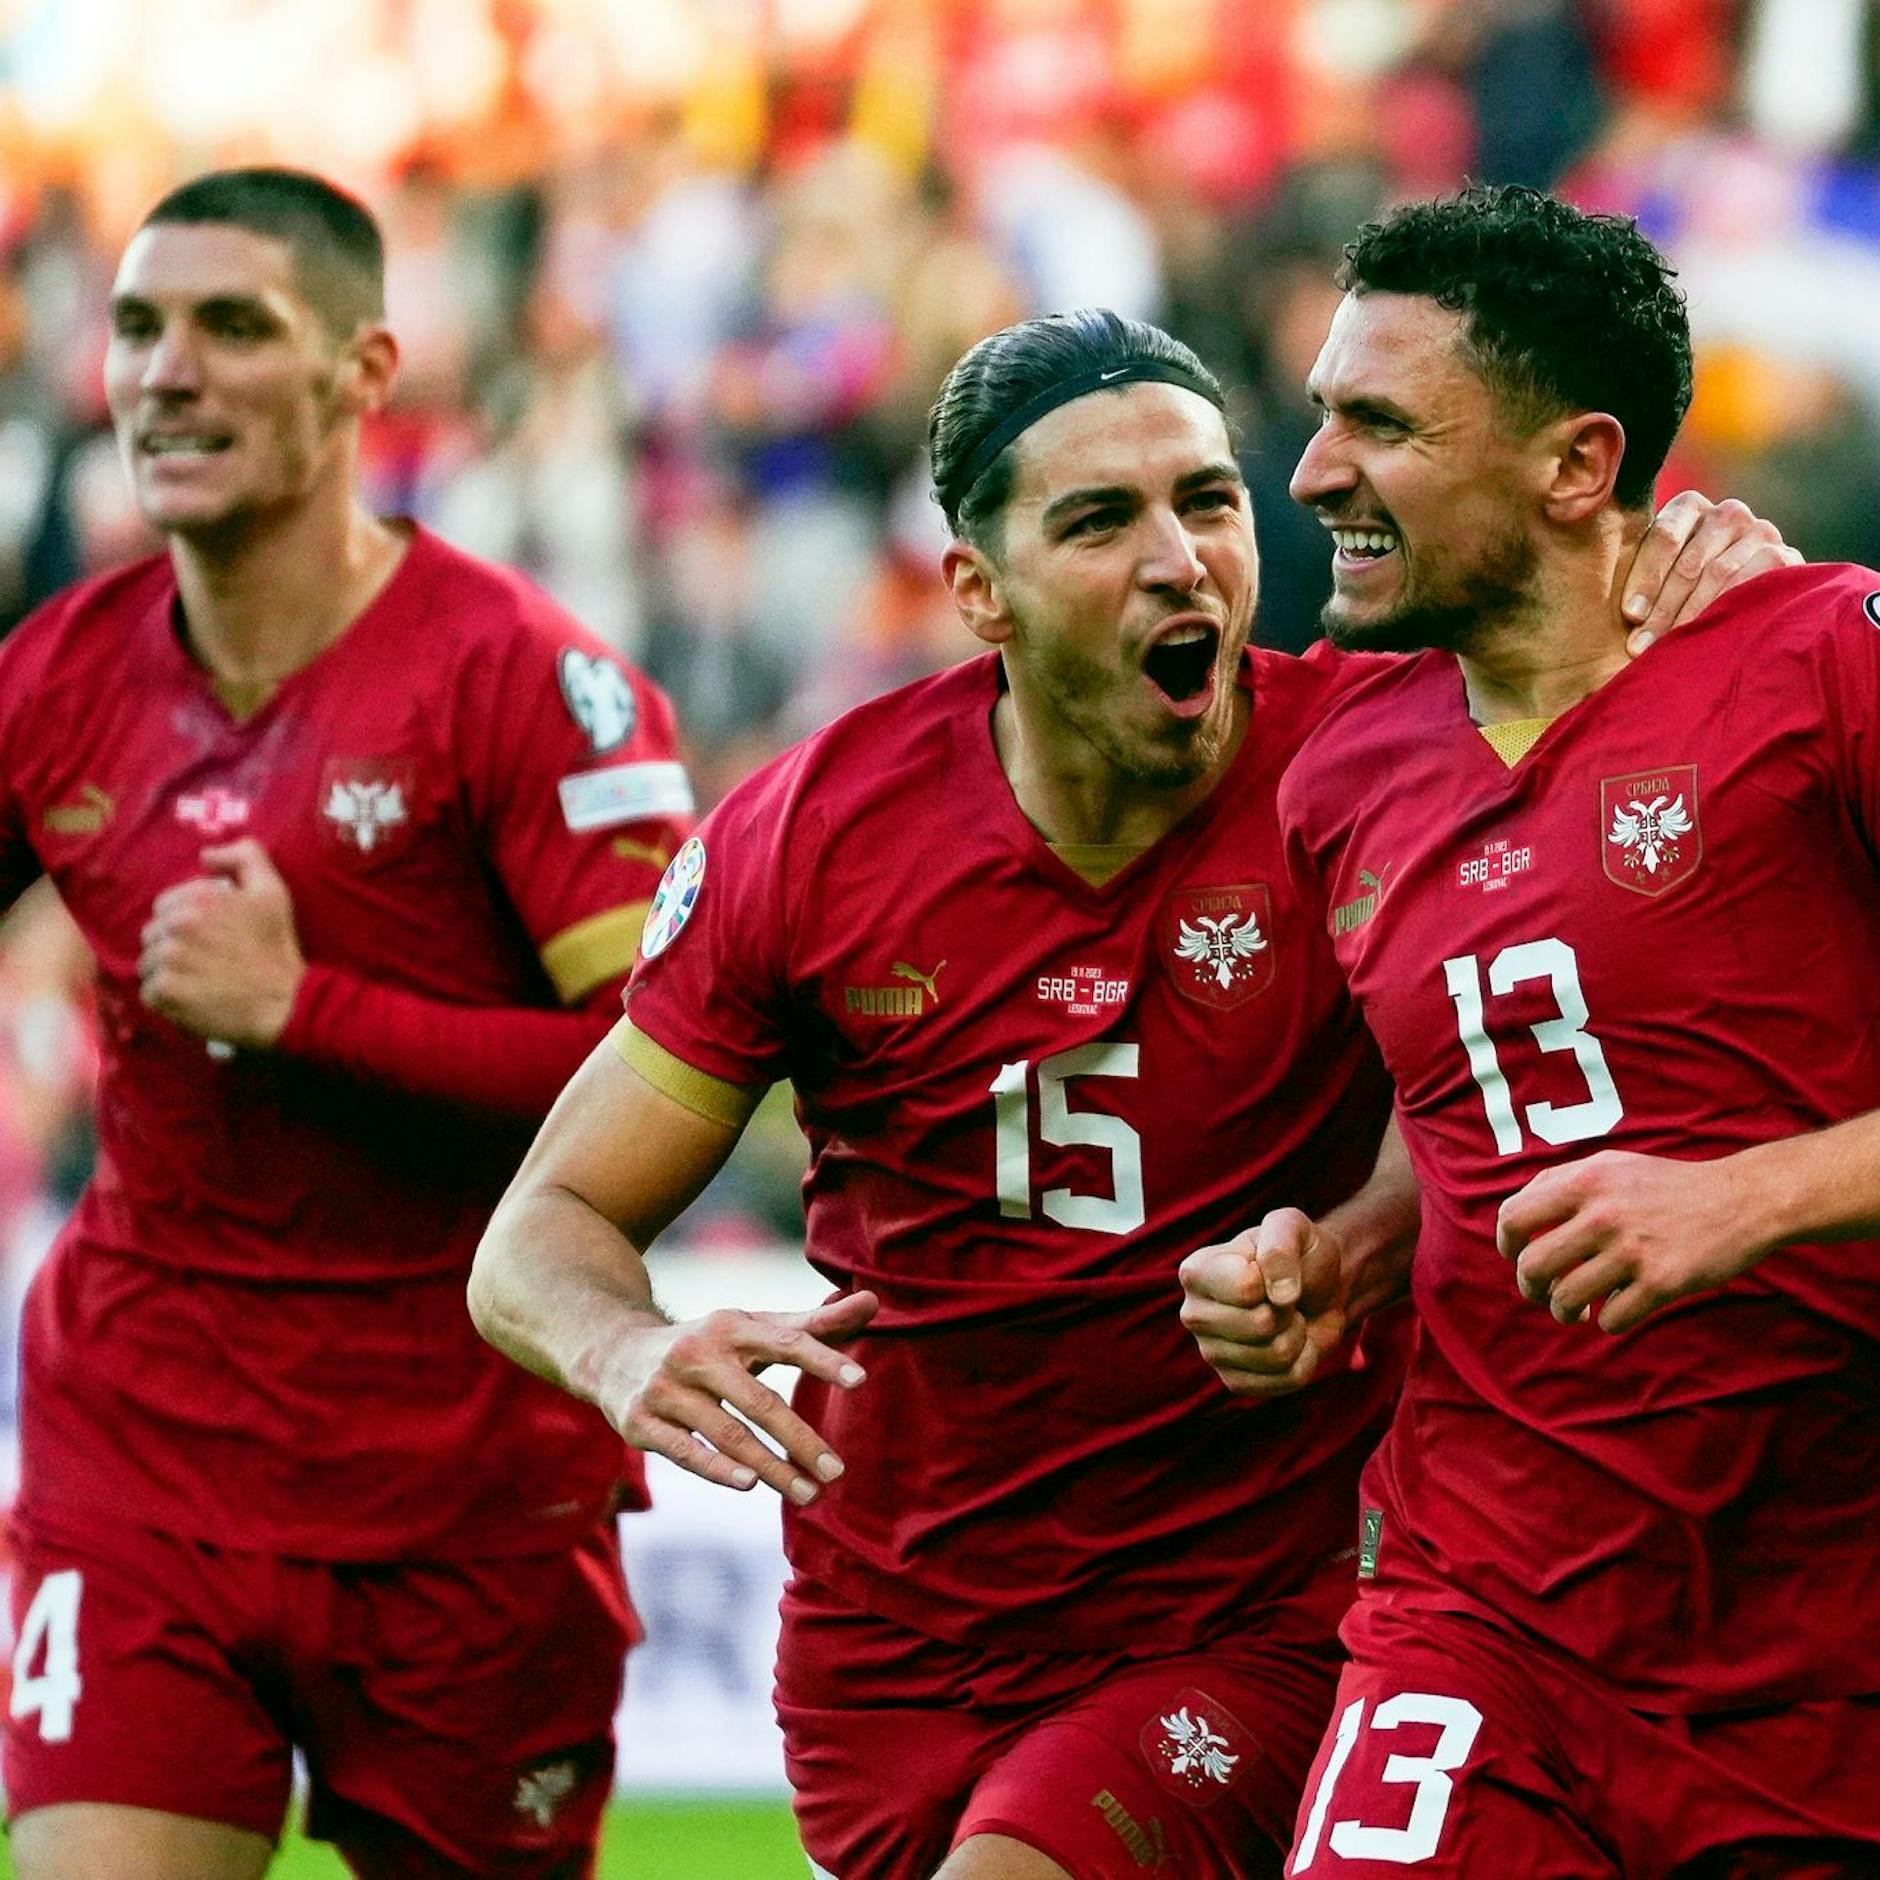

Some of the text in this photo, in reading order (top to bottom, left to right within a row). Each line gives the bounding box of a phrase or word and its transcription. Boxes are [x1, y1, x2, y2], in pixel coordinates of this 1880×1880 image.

[1460, 858, 1489, 886] SRB
[1502, 847, 1530, 875] BGR
[846, 986, 922, 1016] PUMA
[1037, 977, 1076, 1001] SRB
[1093, 981, 1129, 1003] BGR
[1443, 937, 1625, 1156] 13
[989, 1042, 1146, 1236] 15
[10, 1568, 84, 1744] 4
[1291, 1691, 1485, 1877] 13
